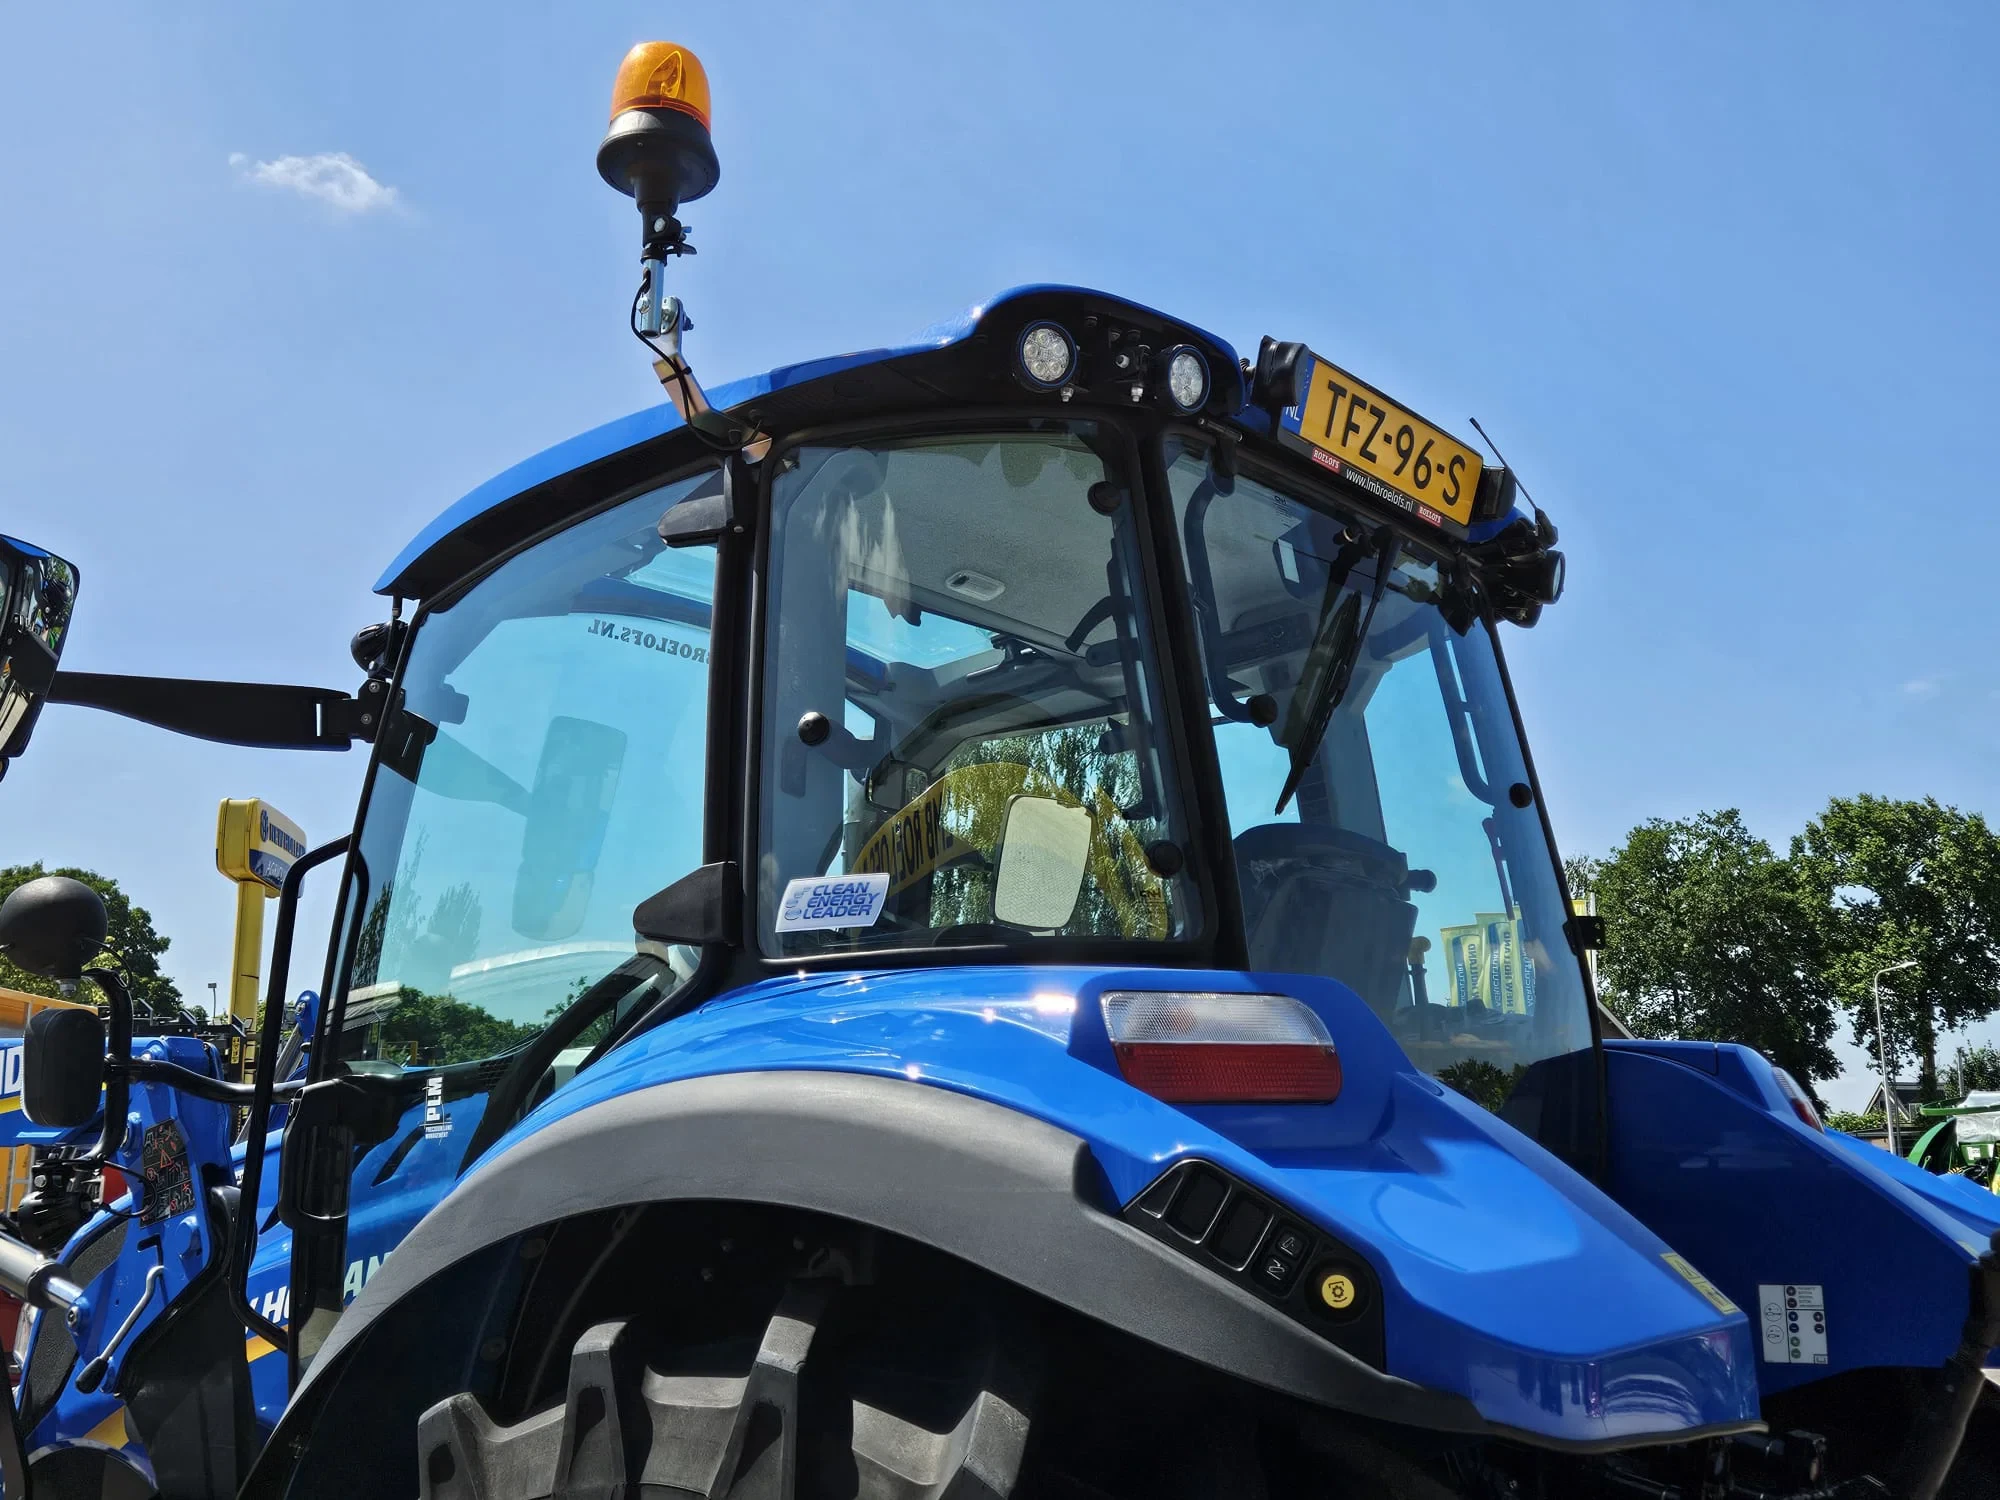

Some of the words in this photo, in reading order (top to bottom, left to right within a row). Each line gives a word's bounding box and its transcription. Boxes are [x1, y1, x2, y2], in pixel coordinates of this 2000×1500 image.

[1285, 404, 1301, 422] NL
[1325, 379, 1466, 506] TFZ-96-S
[1313, 449, 1340, 469] ROELOFS
[1346, 468, 1413, 513] www.lmbroelofs.nl
[1418, 506, 1442, 524] ROELOFS
[813, 882, 870, 896] CLEAN
[807, 893, 880, 908] ENERGY
[803, 905, 872, 919] LEADER
[427, 1077, 443, 1122] PLM
